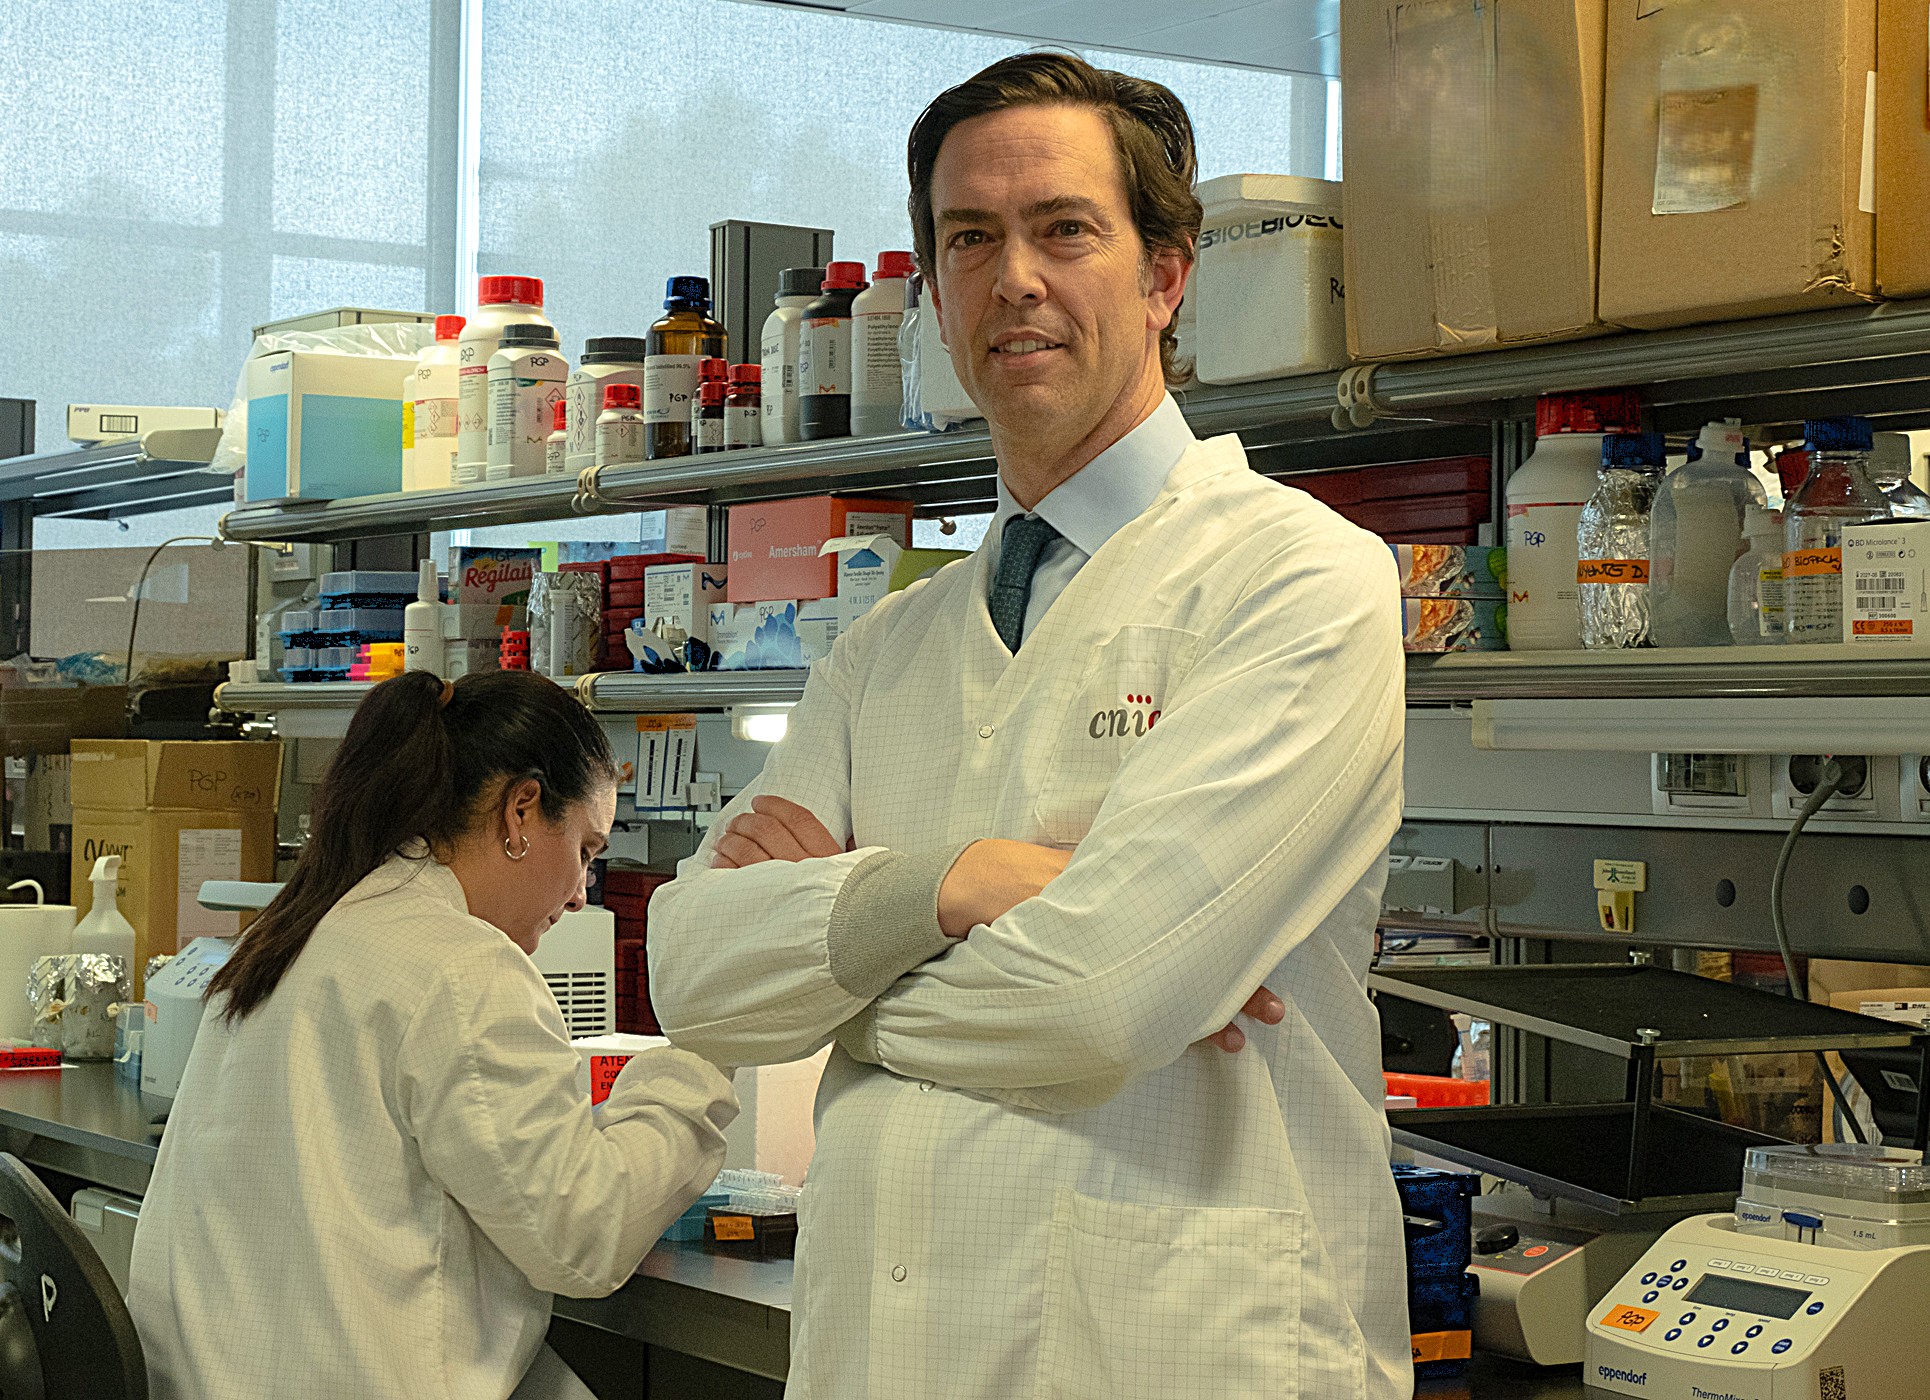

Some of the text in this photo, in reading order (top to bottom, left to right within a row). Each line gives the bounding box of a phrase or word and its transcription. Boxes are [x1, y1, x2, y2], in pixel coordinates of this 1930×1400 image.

[530, 357, 549, 367] PGP
[669, 393, 688, 403] PGP
[1524, 530, 1546, 548] PGP
[1855, 539, 1865, 547] BD
[1902, 537, 1906, 545] 3
[768, 544, 817, 559] Amersham
[187, 769, 227, 792] PGP
[1741, 1210, 1772, 1223] eppendorf
[1852, 1229, 1877, 1240] 1.5 mL
[1615, 1310, 1646, 1326] PGP
[1598, 1364, 1648, 1386] eppendorf
